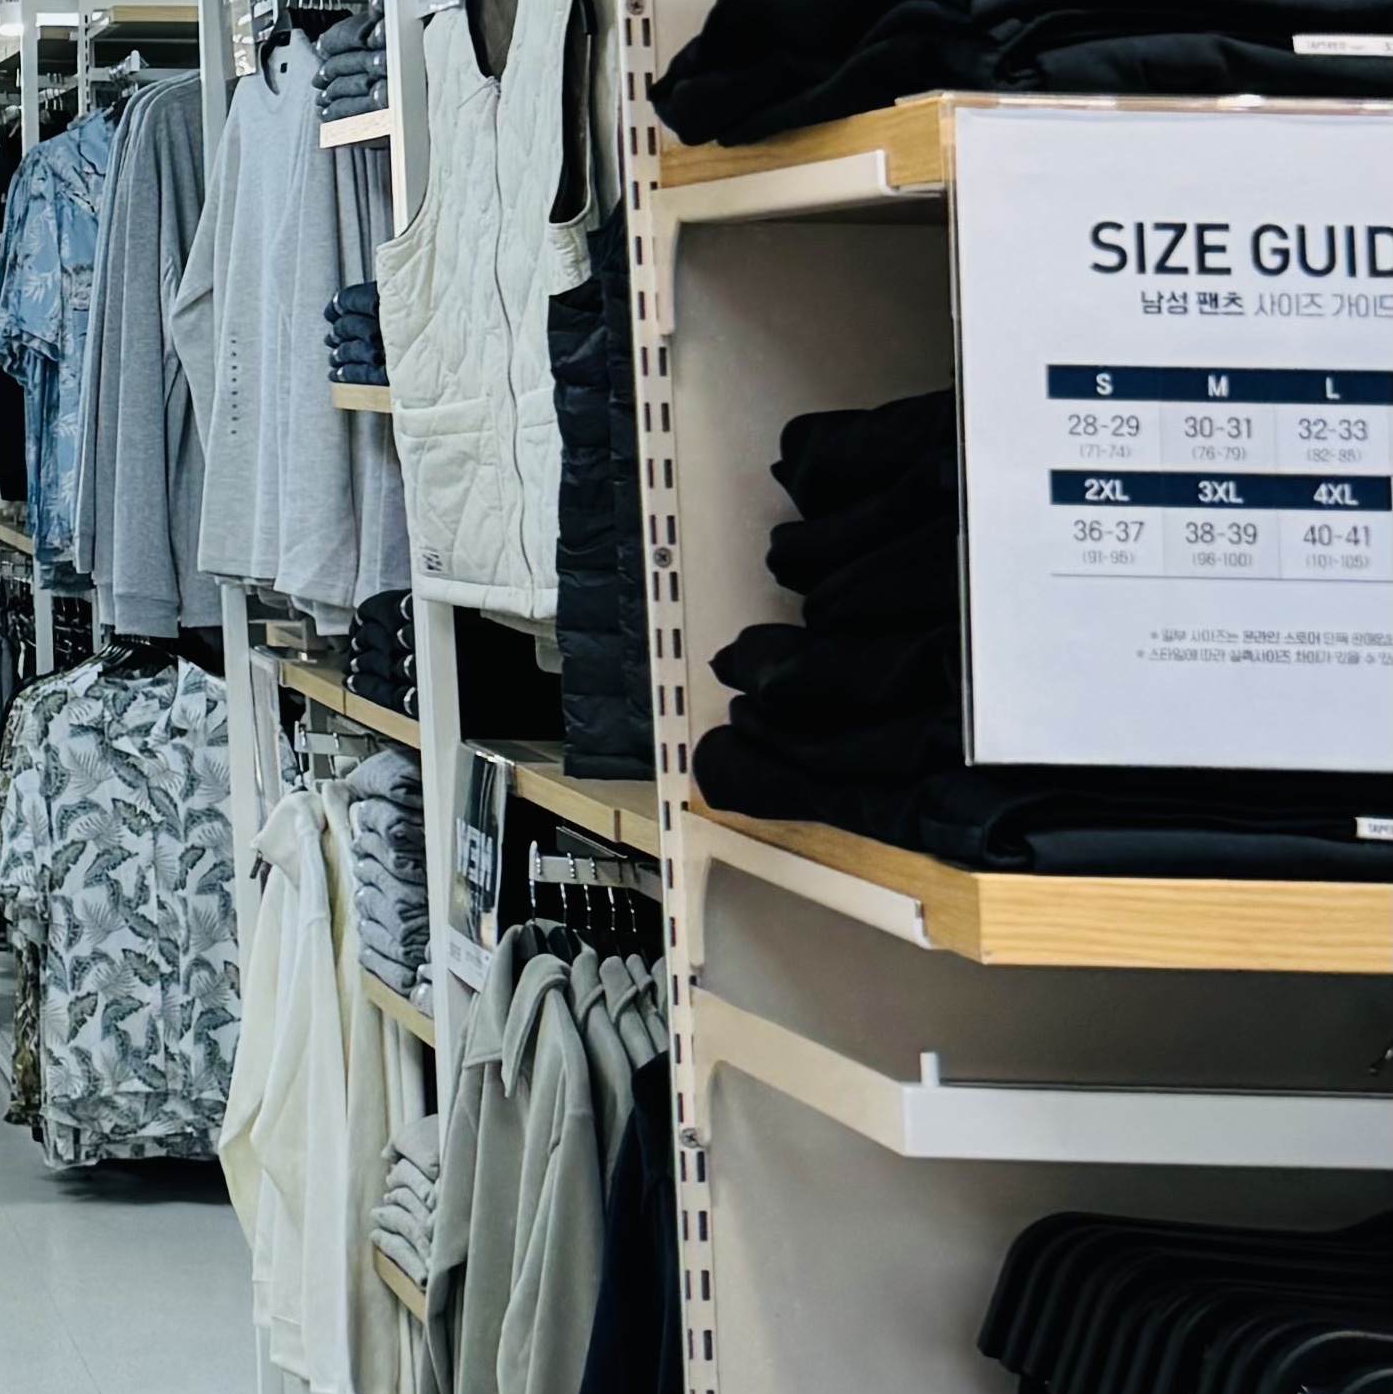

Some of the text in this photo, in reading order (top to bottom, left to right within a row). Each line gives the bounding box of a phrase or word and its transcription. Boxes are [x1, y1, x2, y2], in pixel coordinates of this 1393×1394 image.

[1090, 221, 1393, 278] SIZE GUID
[1141, 291, 1189, 316] 남성
[1195, 291, 1245, 316] 팬츠
[1254, 292, 1325, 317] 사이즈
[1096, 373, 1341, 400] S M L
[1068, 413, 1369, 442] 28-29 30-31 32-33
[1084, 478, 1360, 506] 2XL 3XL 4XL
[1073, 519, 1371, 547] 36-37 38-39 40-41
